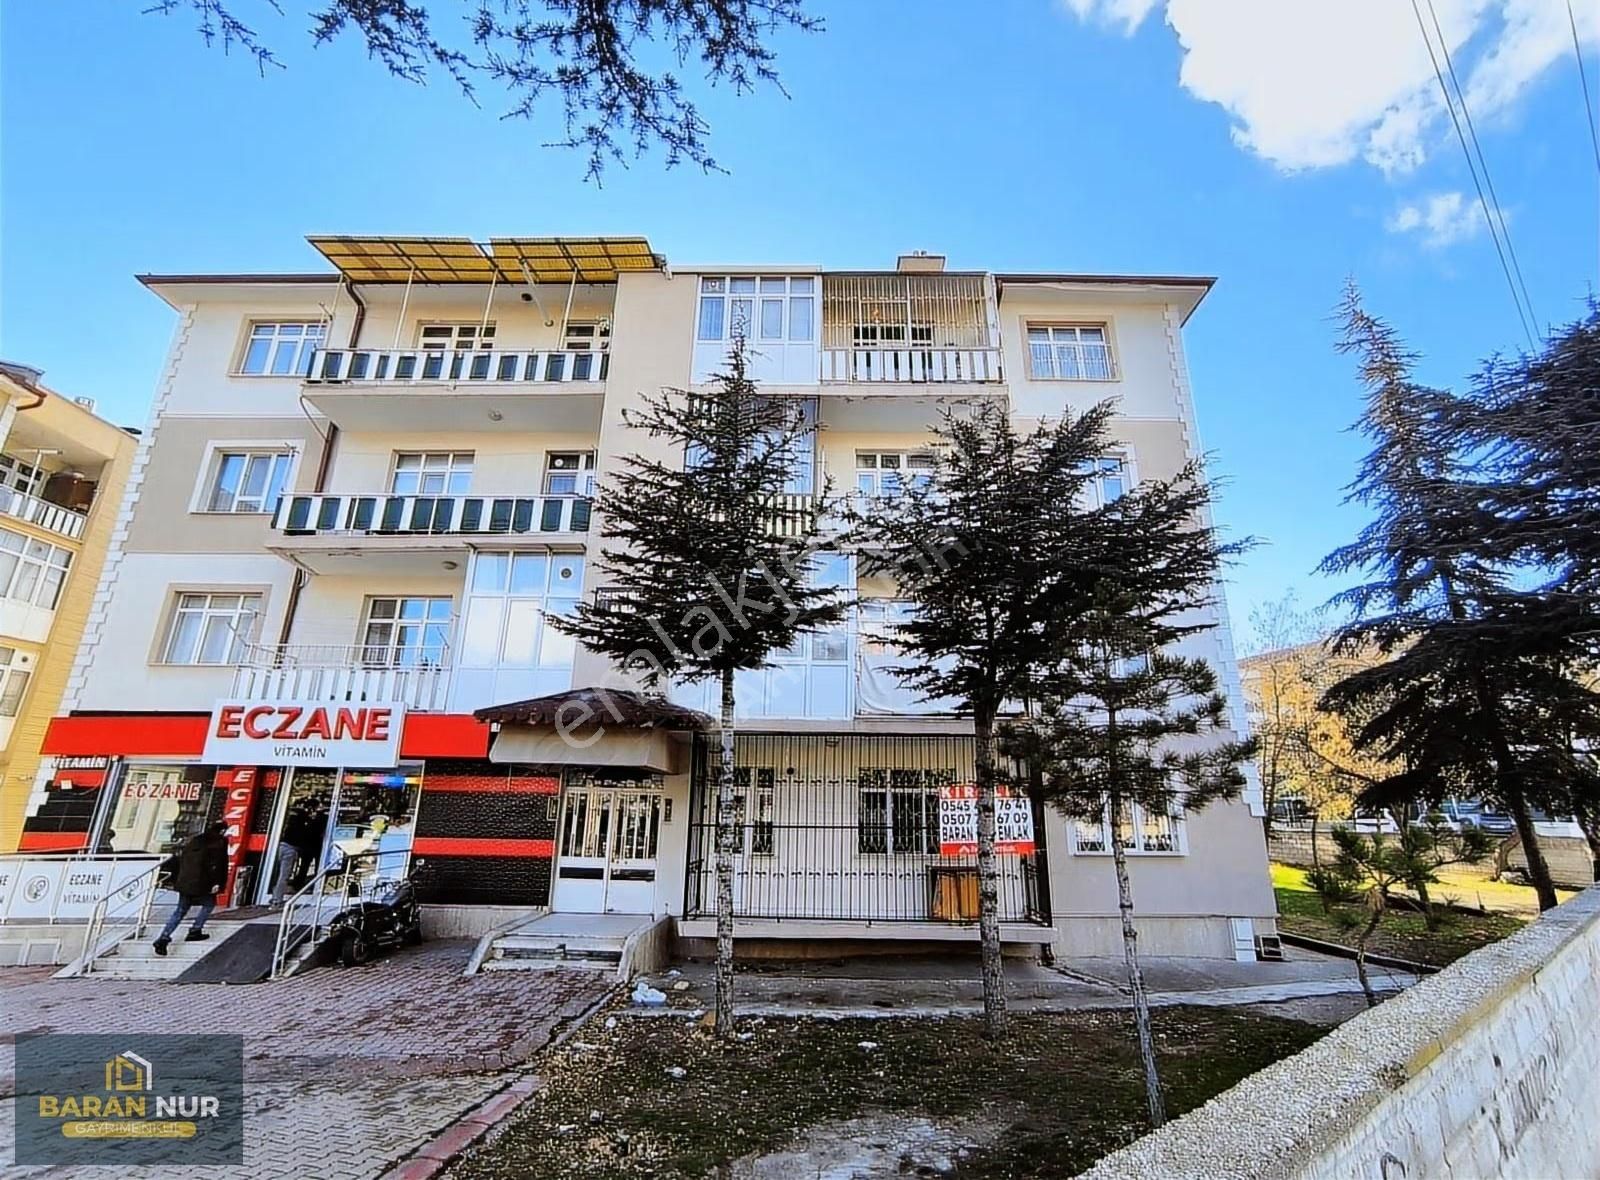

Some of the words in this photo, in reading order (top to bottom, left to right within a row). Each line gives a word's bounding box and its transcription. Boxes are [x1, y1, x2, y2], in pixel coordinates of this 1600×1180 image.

[216, 705, 392, 741] ECZANE
[274, 745, 327, 758] VİTAMİN
[125, 783, 201, 799] ECZANE
[941, 800, 970, 811] 0545
[999, 800, 1012, 810] 76
[1015, 799, 1028, 810] 41
[942, 814, 972, 825] 0507
[996, 814, 1010, 824] 67
[1013, 813, 1028, 823] 09
[942, 827, 974, 841] BARAN
[998, 826, 1030, 840] EMLAK
[69, 873, 104, 886] ECZANE
